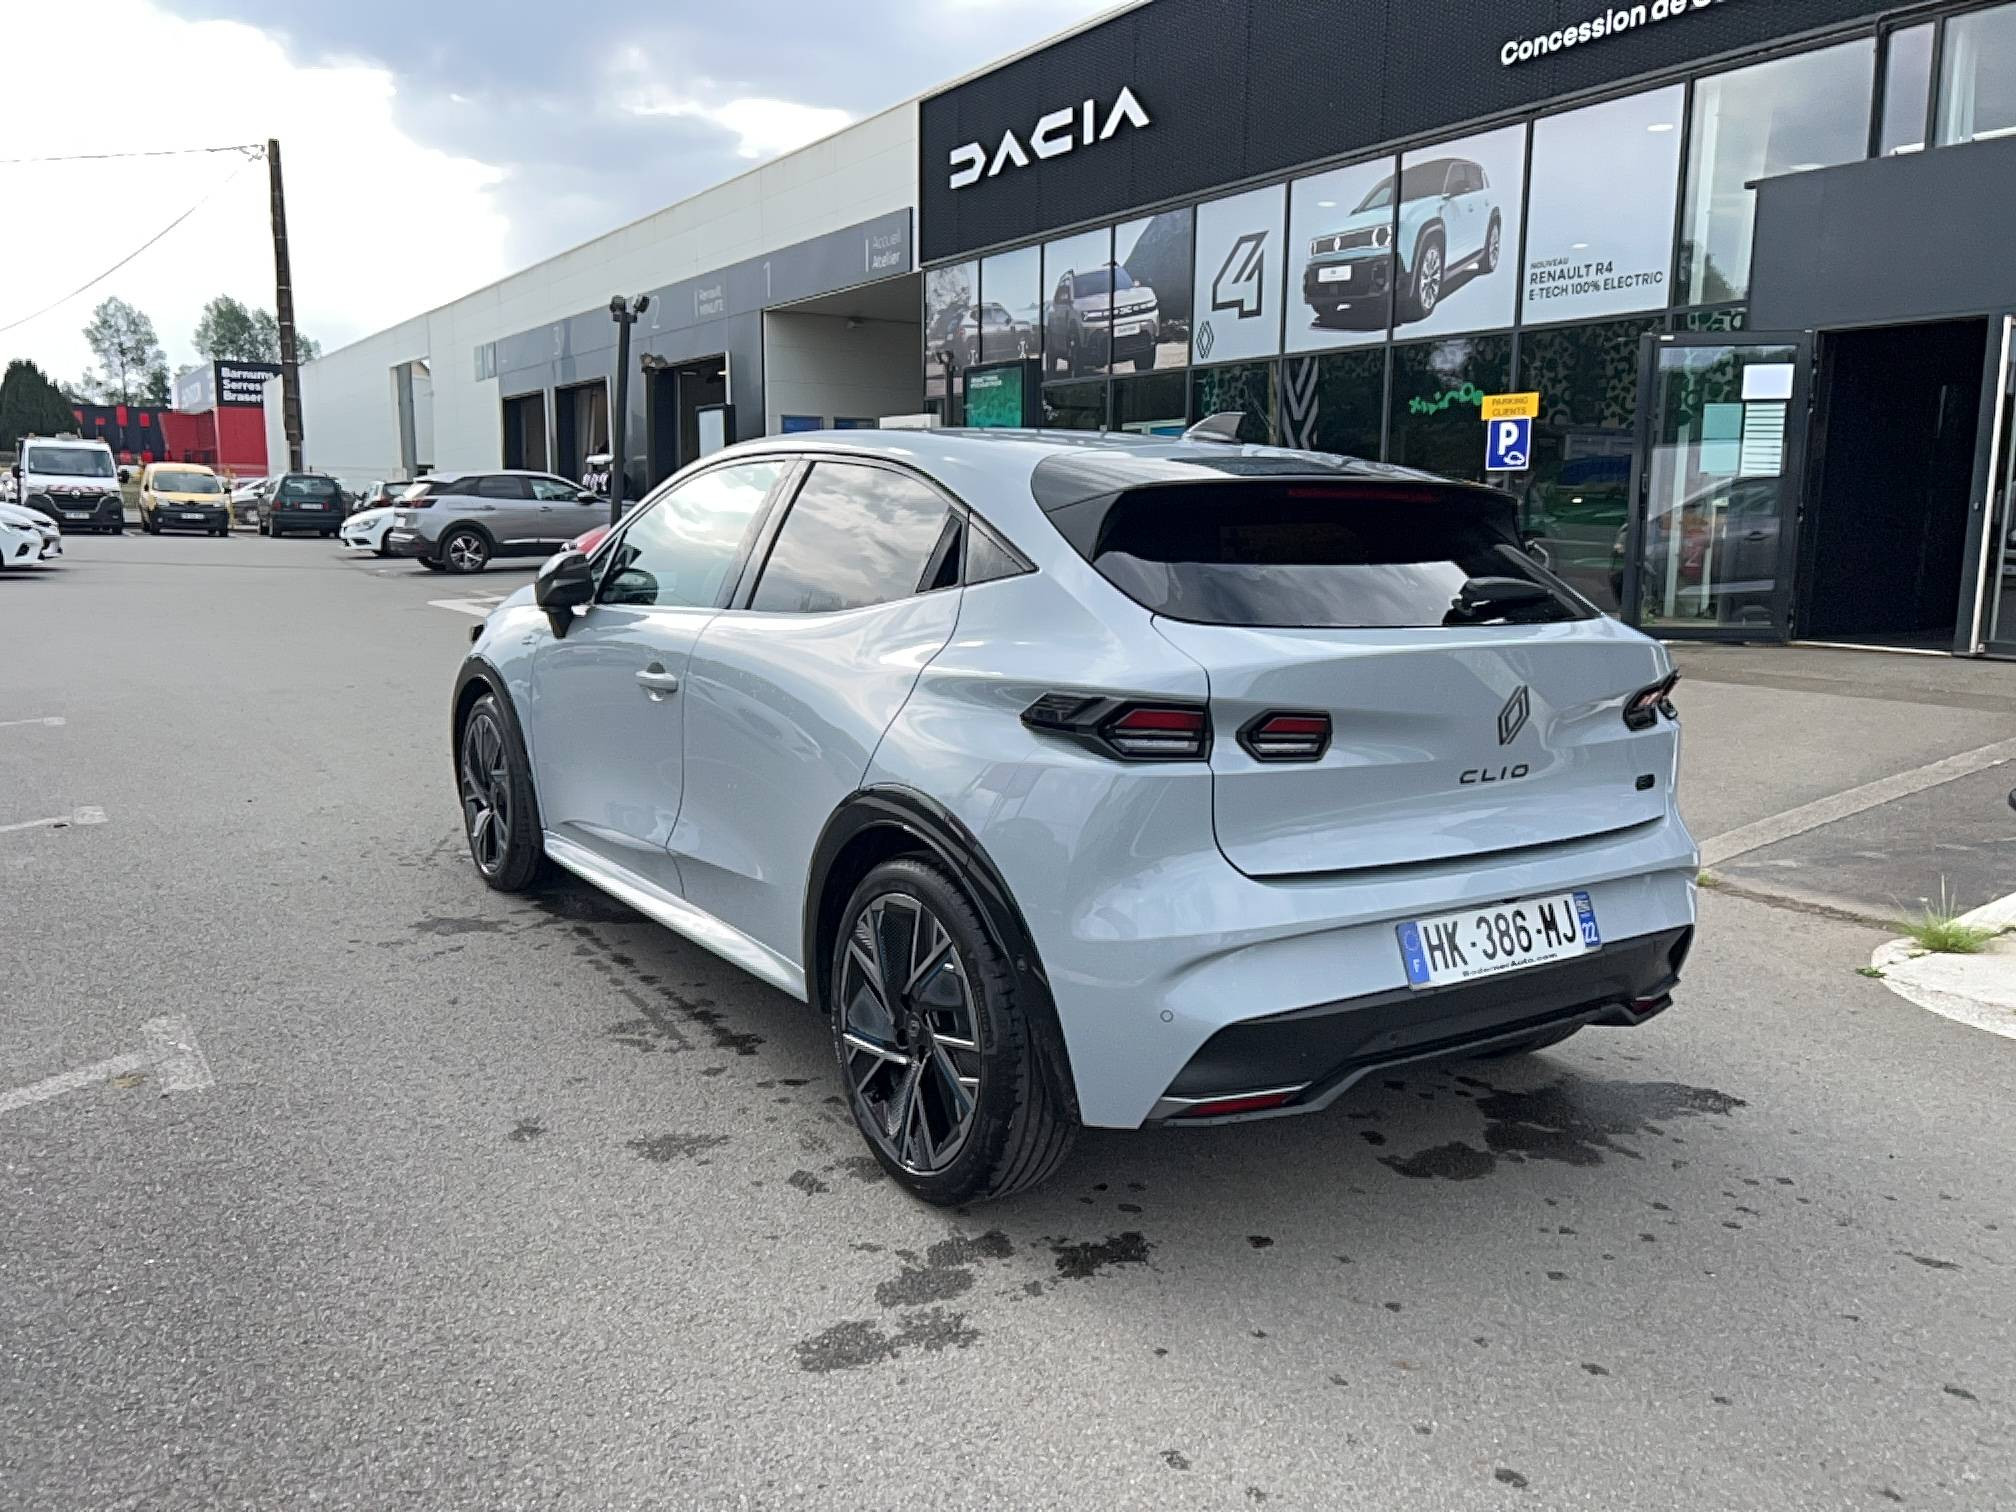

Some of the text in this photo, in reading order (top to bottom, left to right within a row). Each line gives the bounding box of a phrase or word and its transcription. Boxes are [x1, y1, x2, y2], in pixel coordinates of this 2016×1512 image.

[1500, 4, 1647, 66] Concession
[950, 85, 1150, 190] DACIA
[1530, 257, 1569, 270] NOUVEAU
[1530, 260, 1614, 285] RENAULT R4
[762, 261, 772, 299] 1
[1528, 271, 1664, 301] E-TECH 100% ELECTRIC
[650, 295, 660, 329] 2
[552, 326, 562, 356] 3
[1491, 396, 1529, 407] PARKING
[1491, 407, 1527, 417] CLIENTS
[1498, 421, 1519, 456] P
[1459, 764, 1529, 785] CLIO
[1581, 920, 1598, 944] 22
[1412, 958, 1421, 974] F
